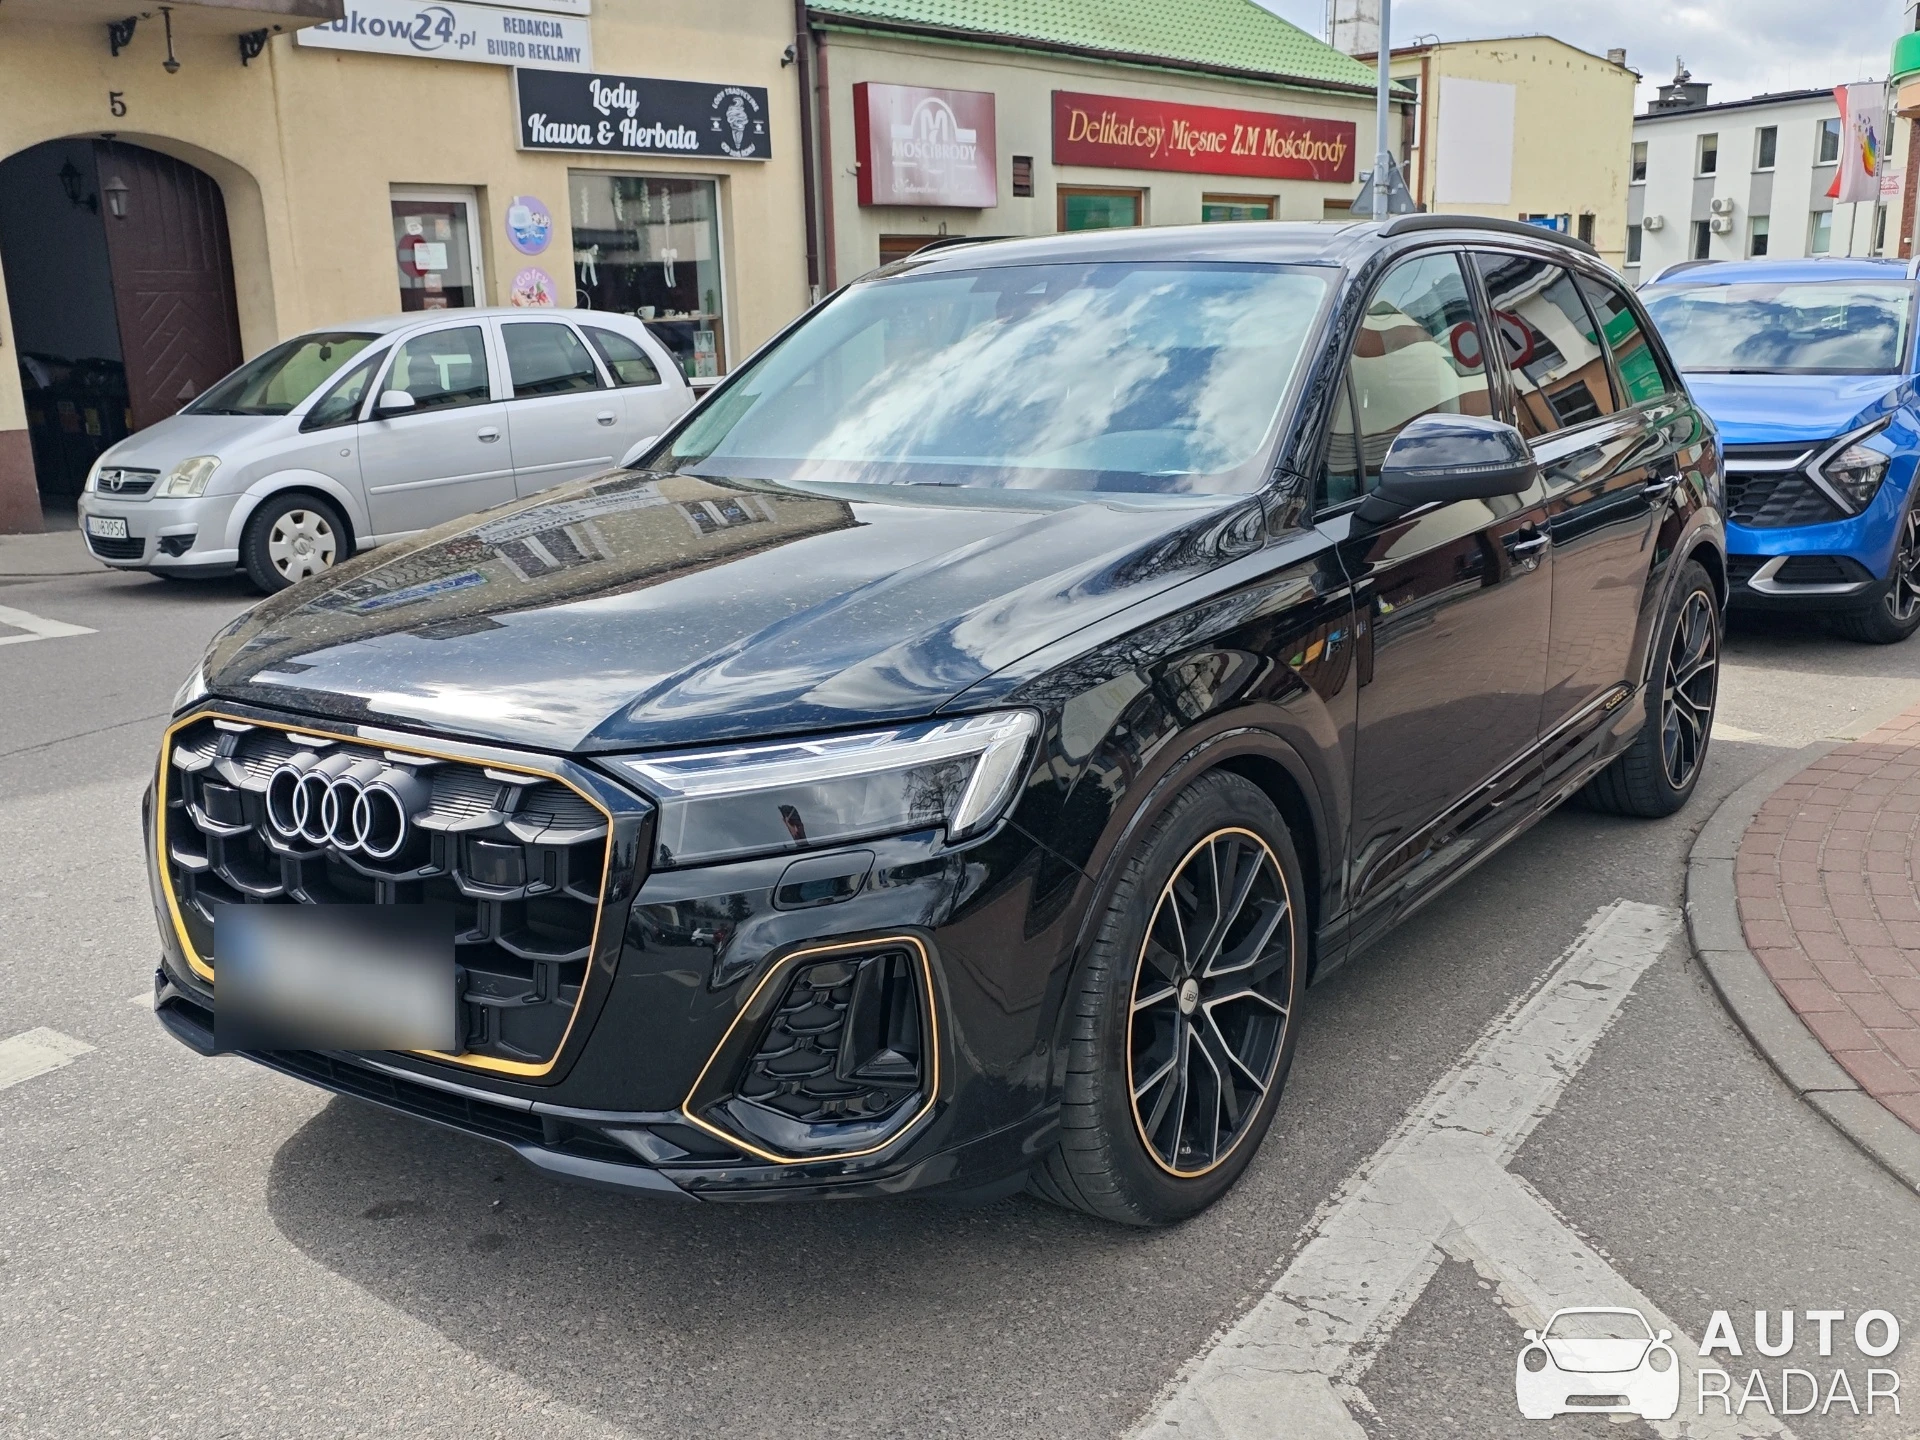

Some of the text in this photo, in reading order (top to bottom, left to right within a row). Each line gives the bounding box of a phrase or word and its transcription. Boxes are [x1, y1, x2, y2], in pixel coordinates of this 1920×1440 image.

[503, 16, 564, 39] REDAKCJA
[487, 38, 581, 64] BIURO REKLAMY
[109, 91, 127, 118] 5
[589, 78, 640, 118] Lody
[527, 113, 700, 150] Kawa & Herbata
[1067, 110, 1166, 159] Delikatesy
[1168, 119, 1228, 157] Mięsne
[1261, 128, 1348, 172] Mościbrody
[516, 268, 549, 287] Gofry
